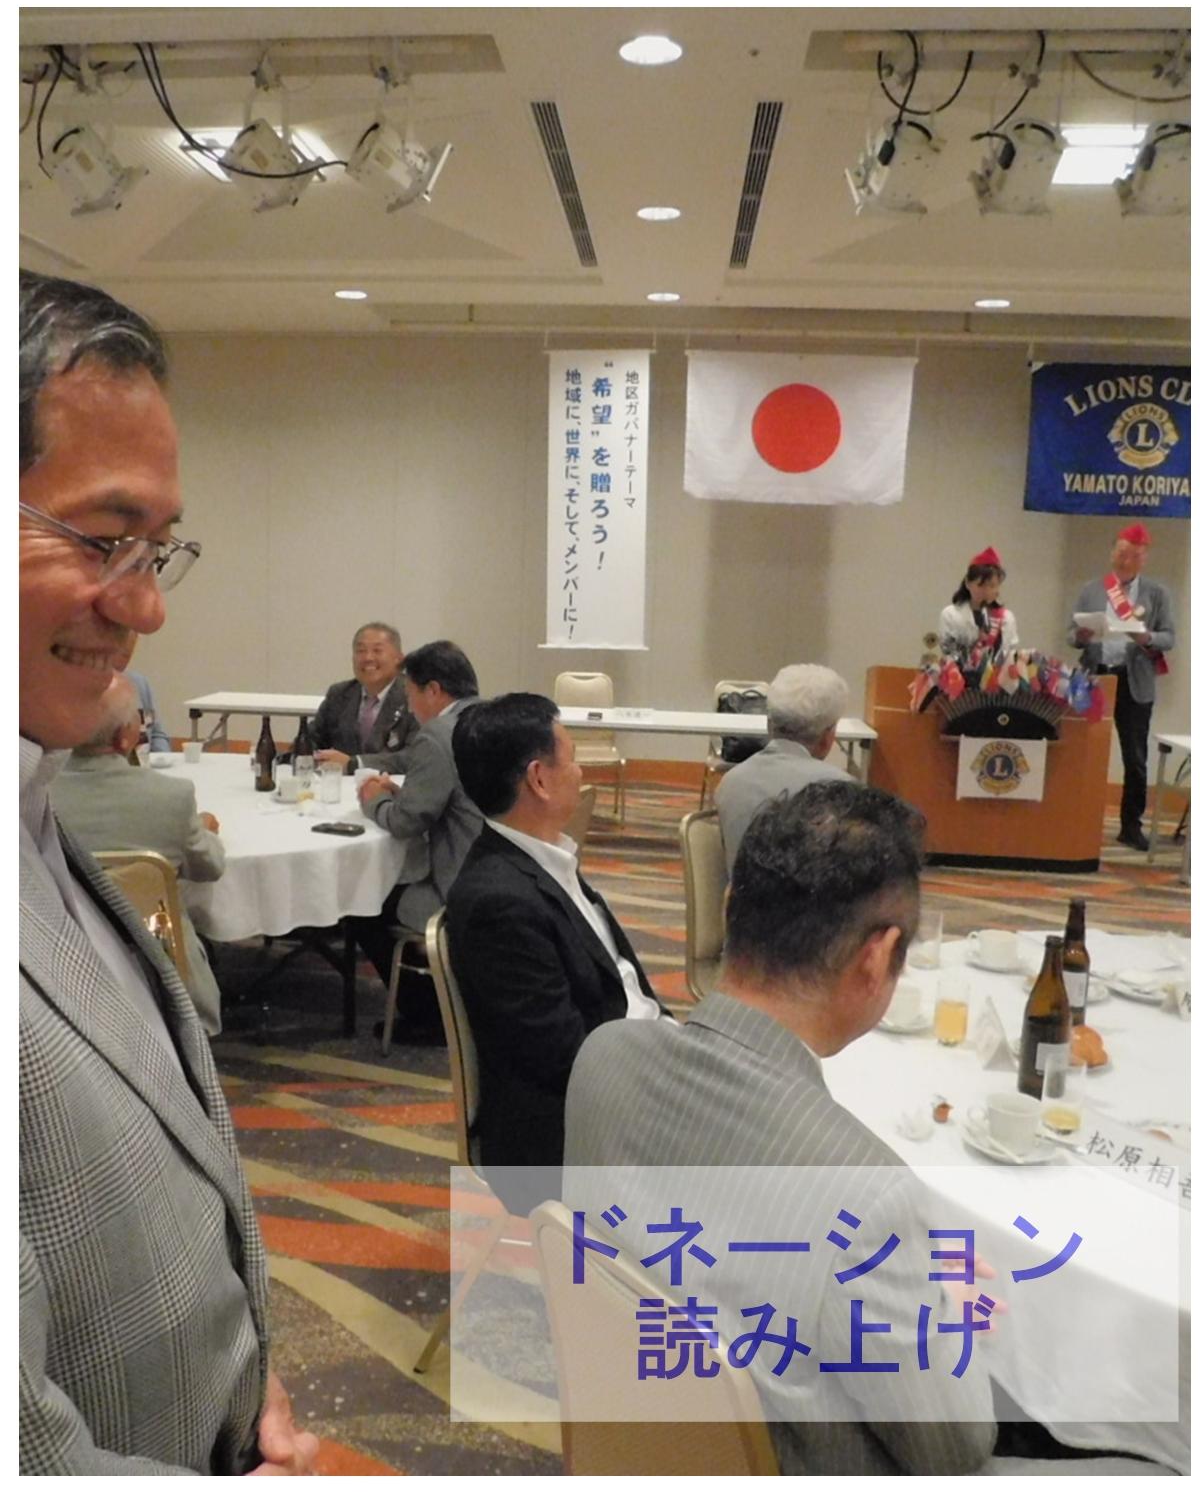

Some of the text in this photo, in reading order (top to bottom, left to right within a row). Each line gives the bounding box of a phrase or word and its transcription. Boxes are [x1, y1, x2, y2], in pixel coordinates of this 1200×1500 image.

[1064, 375, 1154, 417] LIONS
[1125, 405, 1165, 422] LIONS
[623, 370, 640, 509] 地区ガバナーテーマ
[1135, 423, 1154, 448] L
[1063, 472, 1191, 497] YAMATO KORIYA
[1118, 495, 1160, 506] JAPAN
